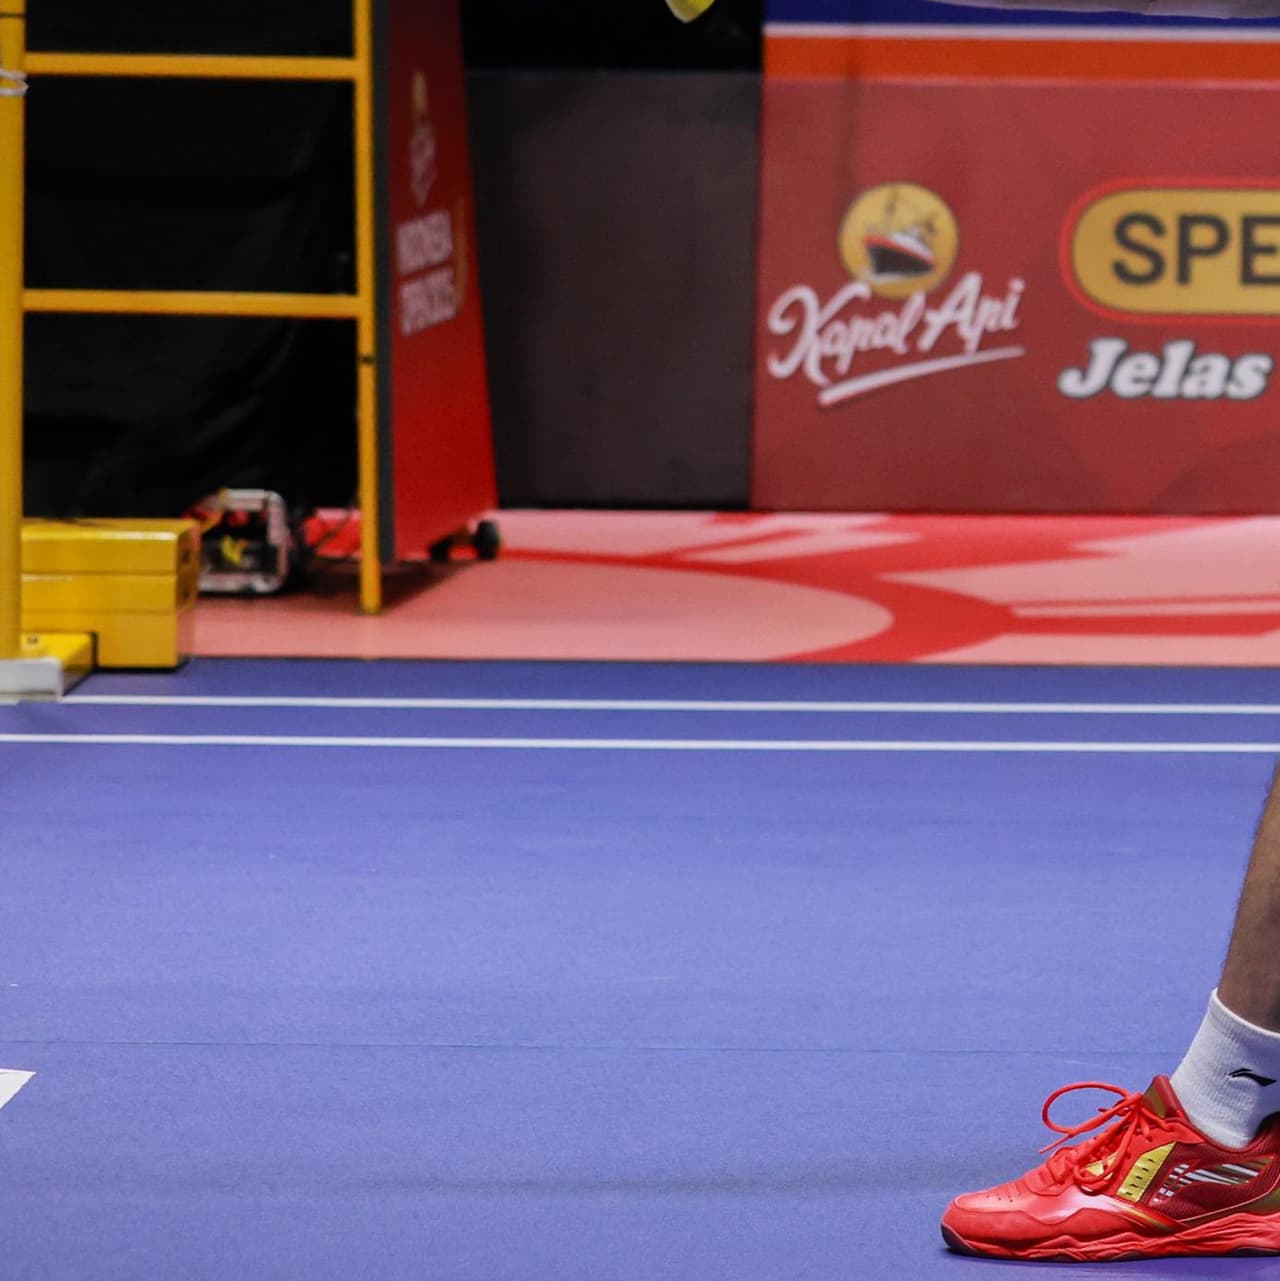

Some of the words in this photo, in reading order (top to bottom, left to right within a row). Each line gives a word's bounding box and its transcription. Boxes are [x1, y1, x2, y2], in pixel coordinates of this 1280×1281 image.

[767, 281, 927, 386] Kapal
[917, 271, 1026, 356] Api
[1057, 336, 1275, 401] Jelas
